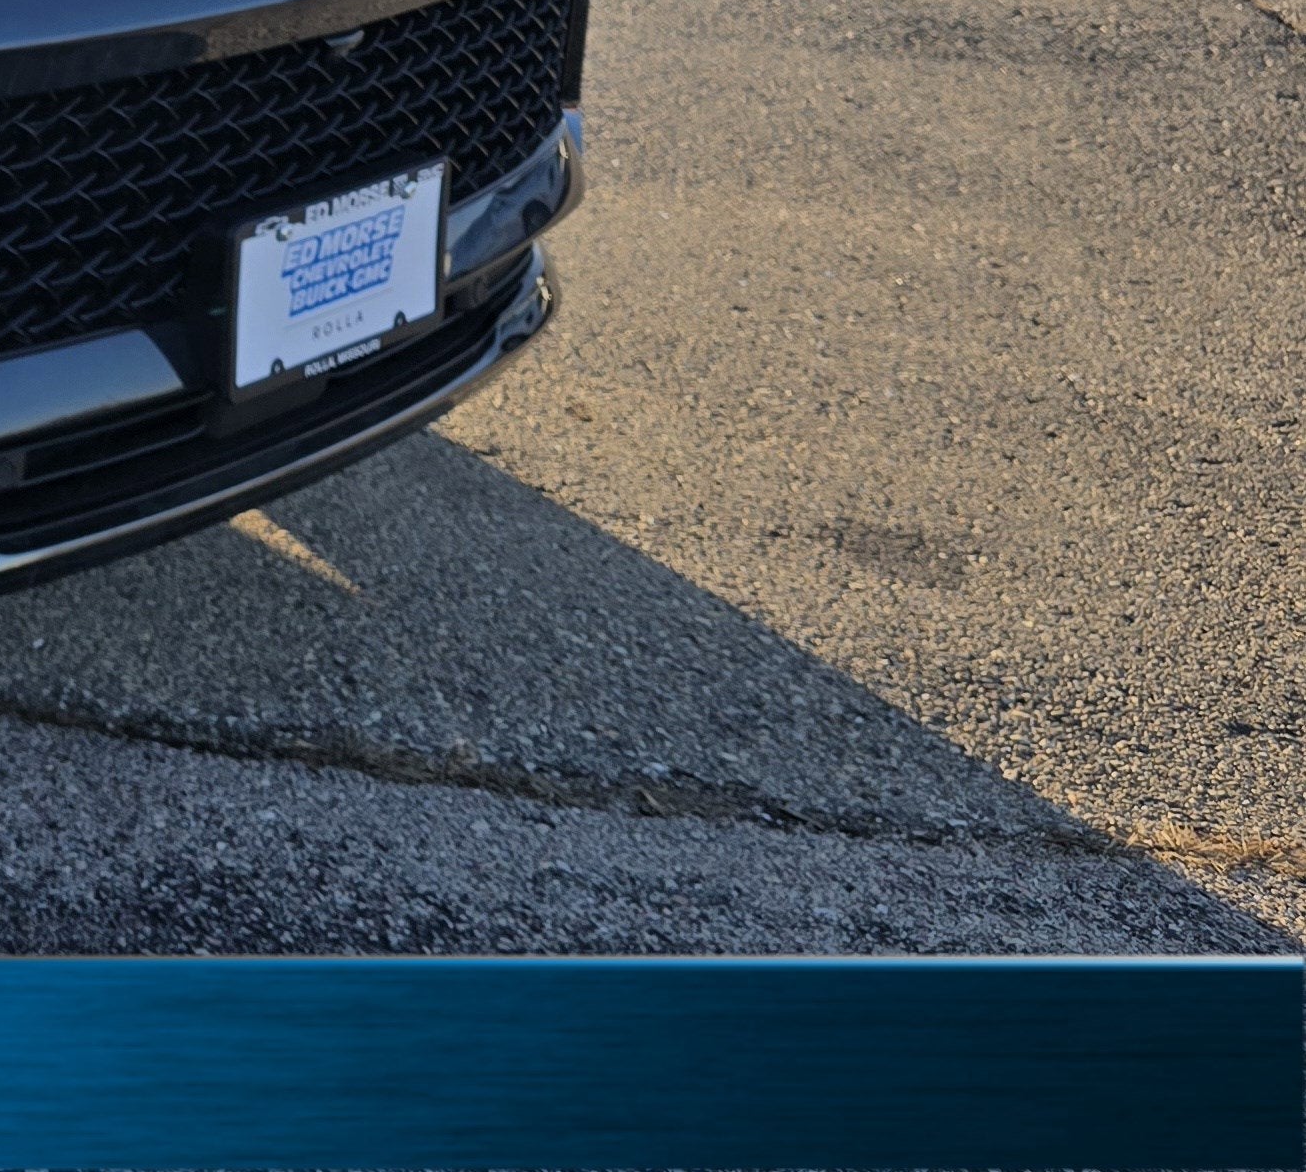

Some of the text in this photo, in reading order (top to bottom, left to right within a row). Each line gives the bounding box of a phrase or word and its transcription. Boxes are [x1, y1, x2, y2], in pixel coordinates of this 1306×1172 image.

[287, 210, 404, 269] ED MORSE
[291, 274, 349, 311] BUICK
[313, 310, 364, 339] ROLLA
